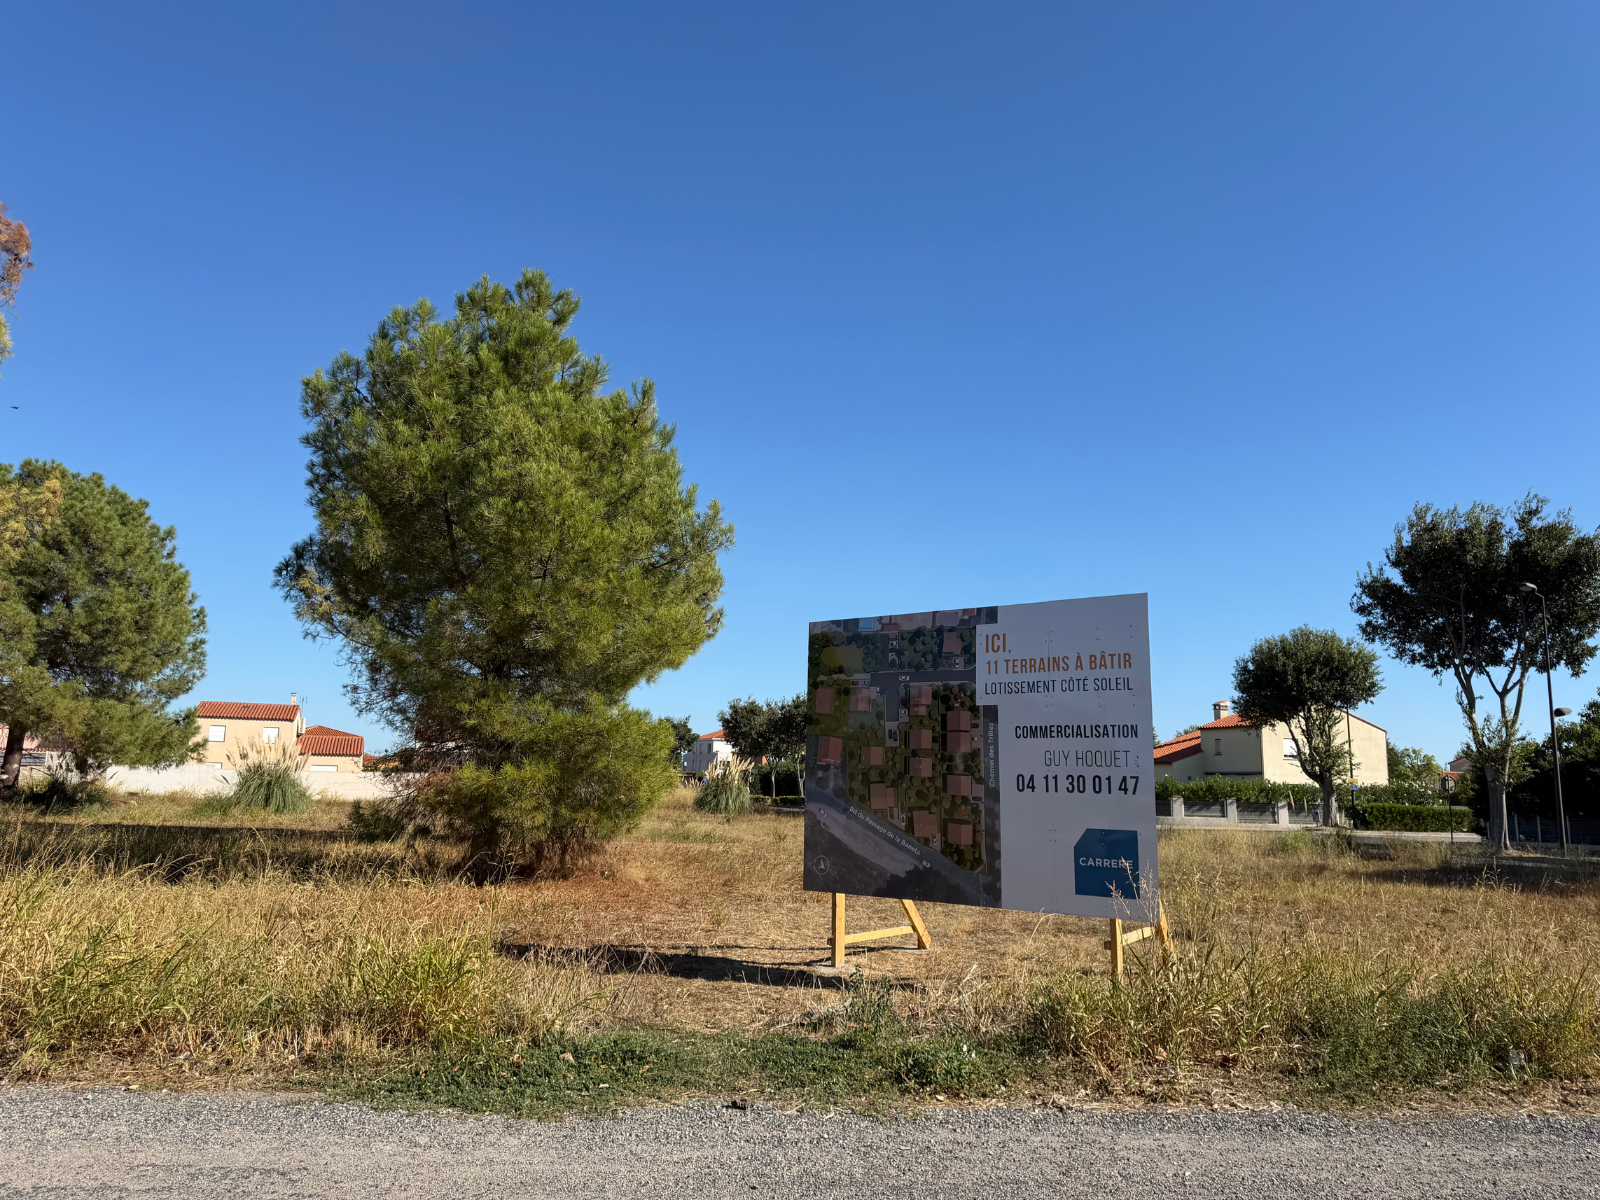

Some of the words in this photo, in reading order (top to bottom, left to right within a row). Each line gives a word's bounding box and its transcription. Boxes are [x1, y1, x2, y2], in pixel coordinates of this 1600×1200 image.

[985, 633, 1011, 654] ICI,
[986, 660, 998, 675] 11
[1004, 655, 1070, 674] TERRAINS
[1075, 652, 1083, 671] À
[1089, 651, 1132, 671] BÂTIR
[985, 679, 1056, 695] LOTISSEMENT
[1061, 676, 1089, 692] CÔTÉ
[1093, 677, 1133, 691] SOLEIL
[1014, 724, 1138, 739] COMMERCIALISATION
[1044, 750, 1070, 767] GUY
[1075, 750, 1130, 768] HOQUET
[1016, 773, 1036, 792] 04
[1043, 774, 1058, 793] 11
[1066, 774, 1086, 794] 30
[1092, 775, 1112, 795] 01
[1118, 775, 1140, 795] 47
[865, 816, 887, 833] Passage
[886, 831, 896, 840] de
[1079, 857, 1134, 869] CARRERE
